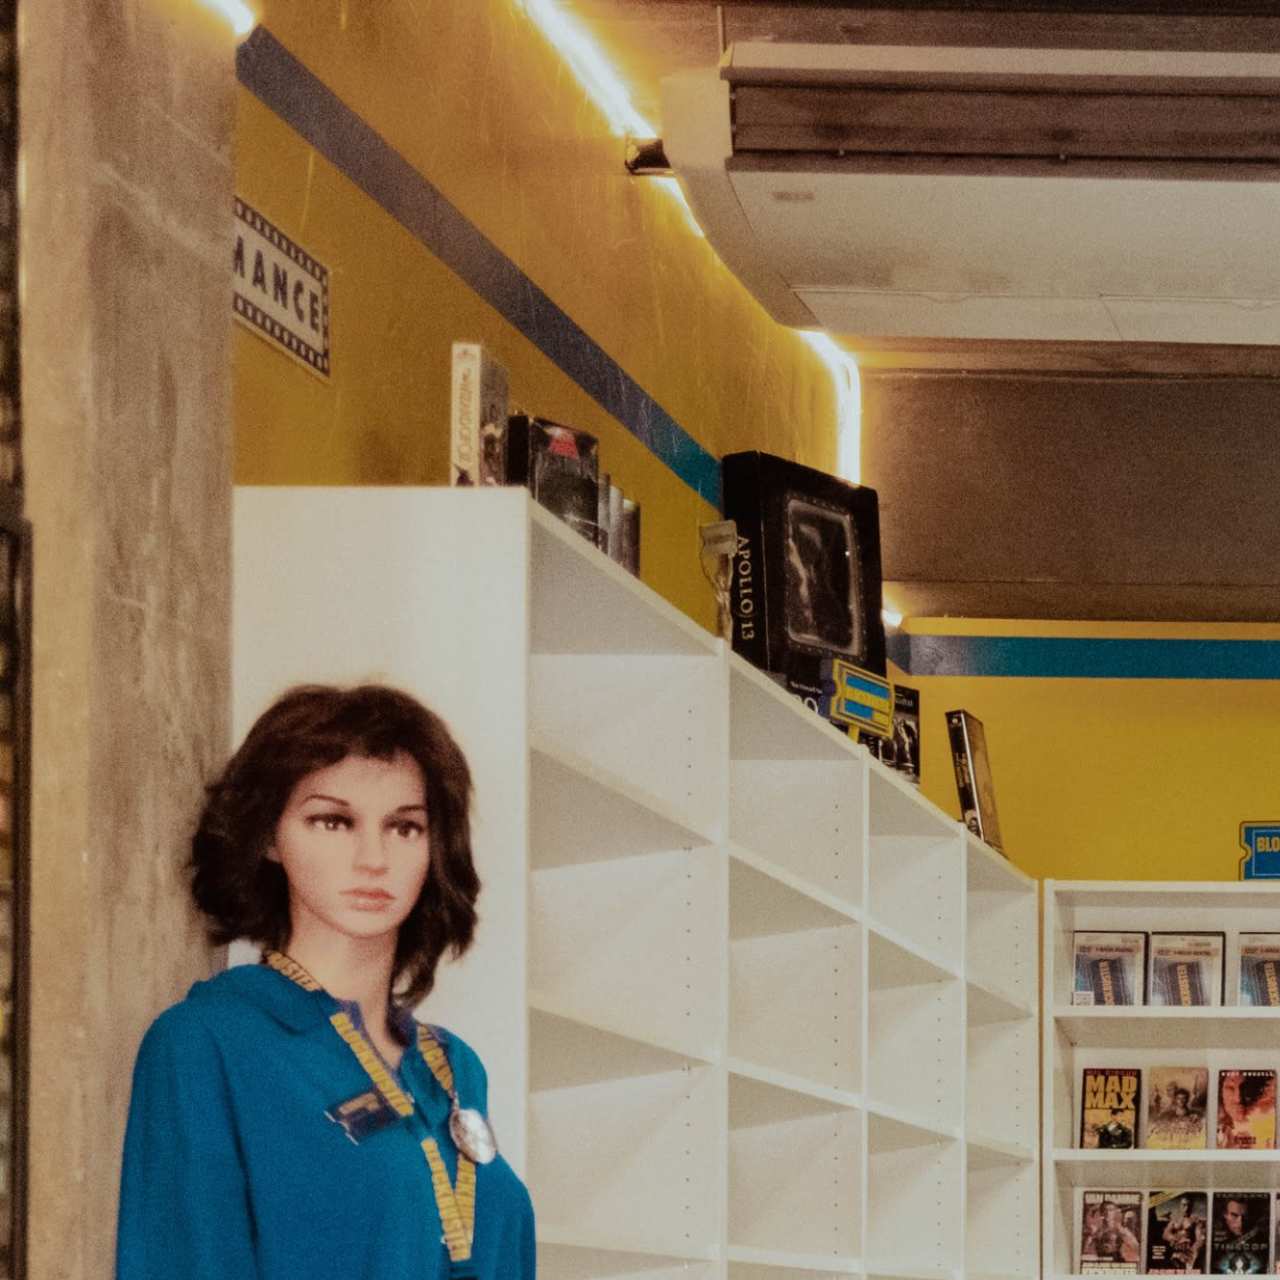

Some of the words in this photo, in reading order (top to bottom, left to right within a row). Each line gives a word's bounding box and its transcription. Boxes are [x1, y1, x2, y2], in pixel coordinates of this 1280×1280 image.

[234, 235, 322, 332] MANCE
[735, 536, 755, 612] APOLLO
[741, 612, 755, 641] 13
[1086, 1076, 1137, 1092] MAD
[1085, 1091, 1135, 1108] MAX
